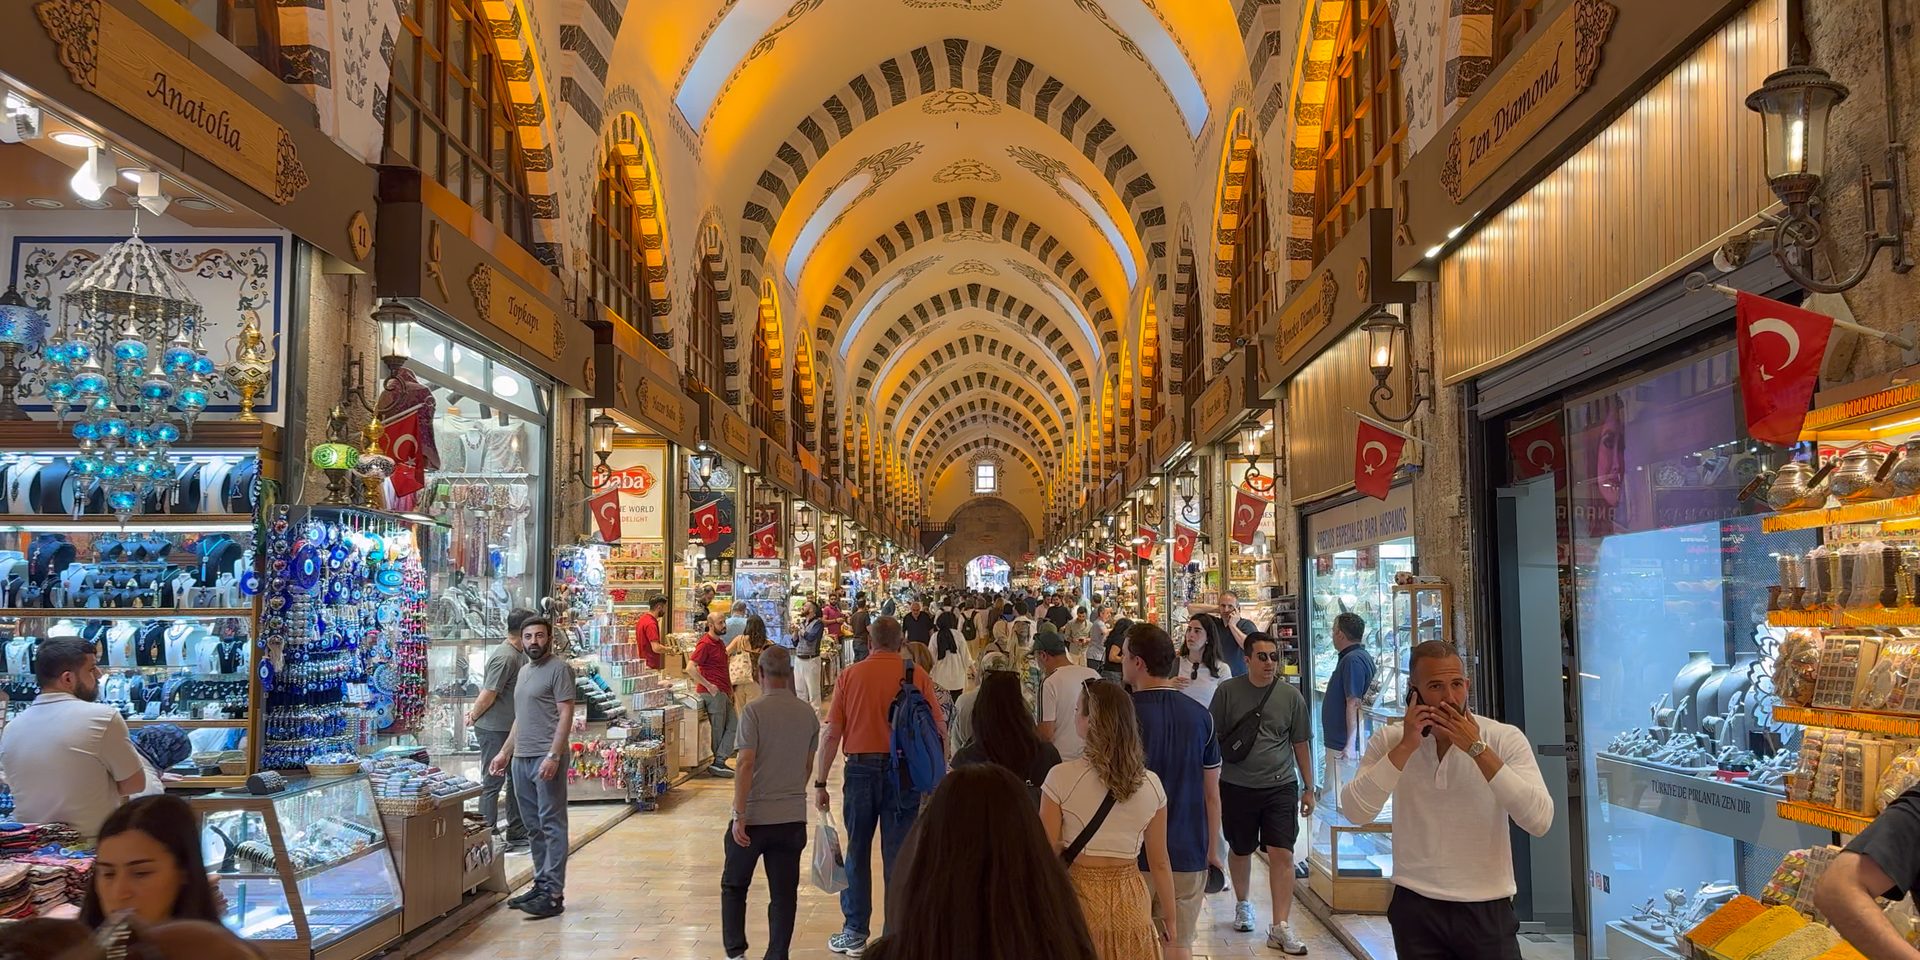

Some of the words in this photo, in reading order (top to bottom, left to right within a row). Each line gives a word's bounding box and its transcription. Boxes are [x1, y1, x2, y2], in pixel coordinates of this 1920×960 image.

[147, 72, 242, 152] Anatolia
[1468, 129, 1490, 168] Zen
[1493, 41, 1563, 143] Diamond
[359, 225, 367, 248] 11
[508, 296, 539, 334] Topkapı
[592, 472, 645, 489] rBaba
[629, 505, 655, 513] WORLD
[1364, 515, 1378, 540] PARA
[1380, 506, 1407, 536] HISPANOS
[1721, 795, 1736, 811] ZEN
[1737, 796, 1751, 814] DİR
